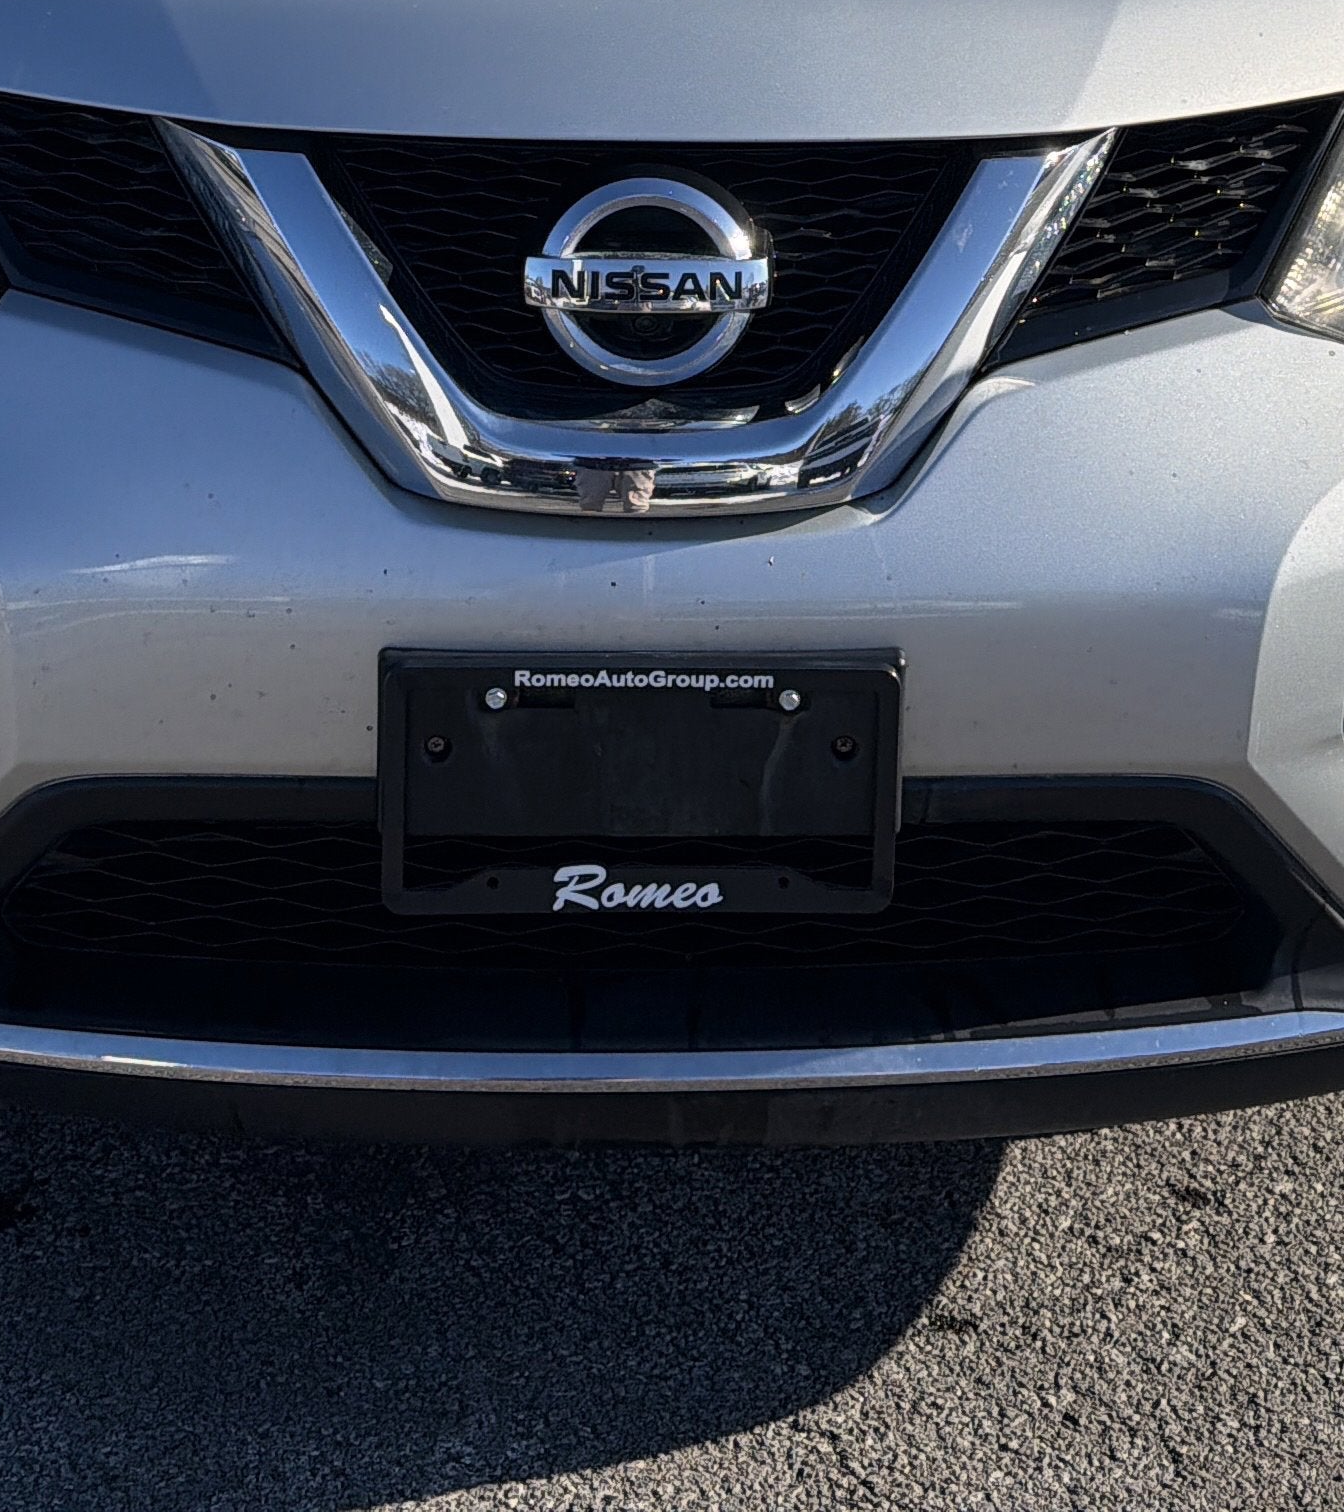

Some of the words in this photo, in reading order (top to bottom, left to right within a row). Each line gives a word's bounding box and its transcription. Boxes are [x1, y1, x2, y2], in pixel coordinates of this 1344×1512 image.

[551, 267, 743, 301] NISSAN
[513, 669, 774, 691] RomeoAutoGroup.com
[552, 864, 723, 912] Romeo
